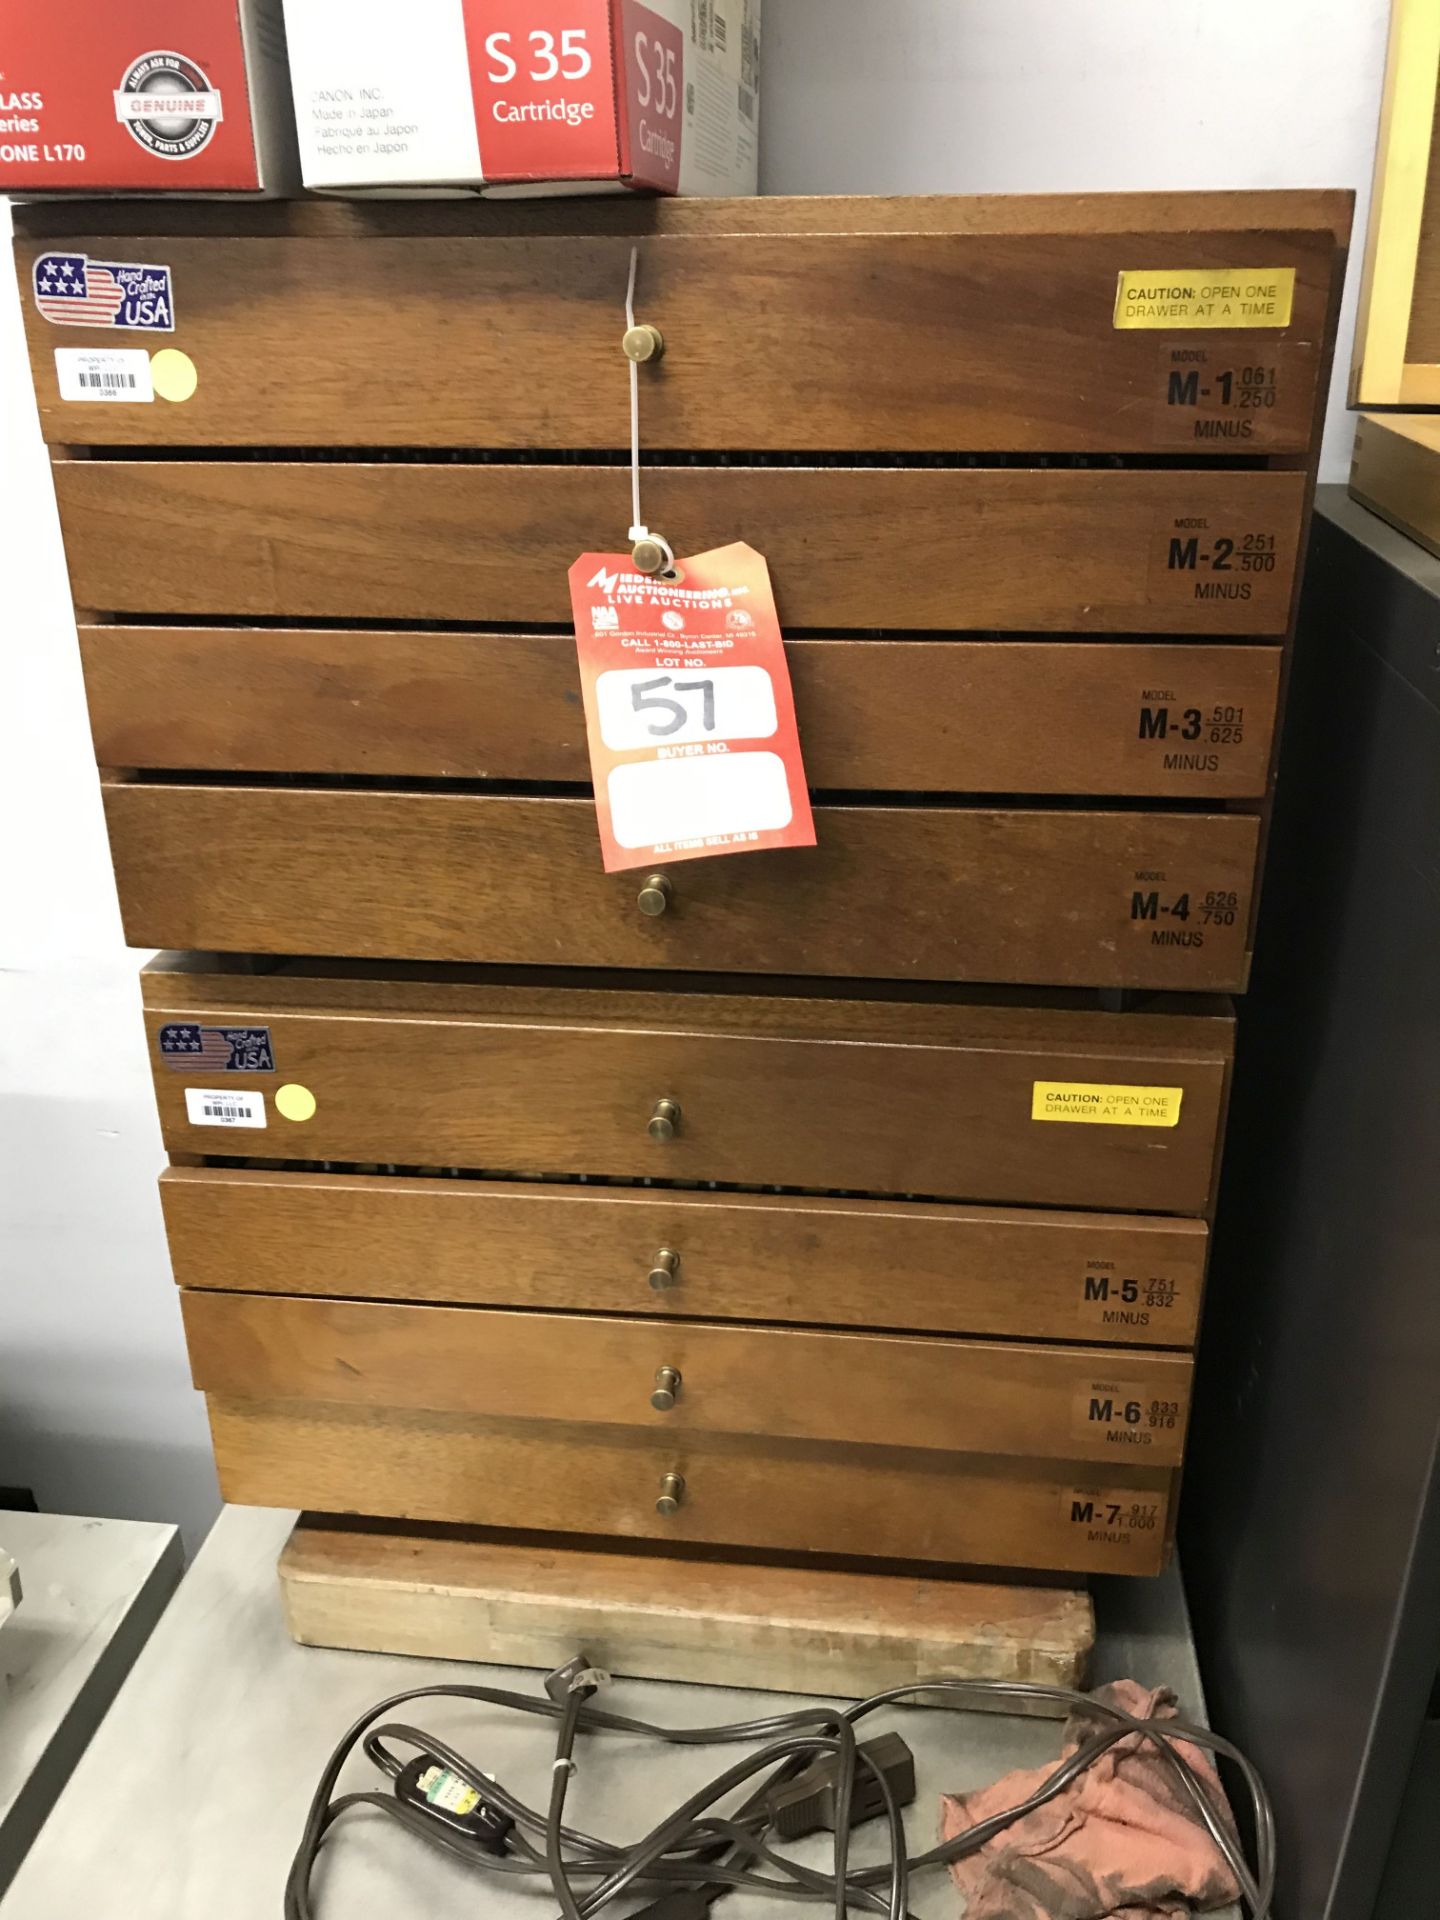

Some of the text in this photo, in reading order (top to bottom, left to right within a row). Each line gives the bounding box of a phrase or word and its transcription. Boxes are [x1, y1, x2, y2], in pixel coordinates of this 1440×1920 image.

[149, 57, 165, 69] ASK
[165, 57, 180, 70] FOR
[484, 29, 592, 83] S 35
[634, 31, 651, 107] S
[654, 40, 677, 119] 35
[130, 99, 206, 113] GENUINE
[360, 106, 394, 120] Japan
[492, 100, 595, 126] Cartridge
[154, 140, 179, 153] PARTS
[184, 120, 210, 151] SUPPLIES
[384, 123, 418, 136] Japon
[44, 144, 85, 162] L170
[374, 142, 408, 154] Japon
[639, 119, 675, 171] Cartridge
[116, 267, 143, 284] Hand
[127, 275, 166, 296] Crafted
[1126, 285, 1277, 301] CAUTION: OPEN ONE
[125, 296, 169, 325] USA
[1125, 302, 1275, 317] DRAWER AT A TIME
[1171, 350, 1208, 362] MODEL
[1167, 371, 1233, 405] M-1
[1194, 420, 1252, 437] MINUS
[1174, 518, 1210, 529] MODEL
[1167, 537, 1234, 570] M-2
[1194, 583, 1252, 600] MINUS
[608, 595, 733, 609] LIVE AUCTIONS
[621, 638, 734, 649] CALL 1-800-LAST-BID
[656, 657, 707, 667] LOT NO.
[1142, 690, 1176, 701] MODEL
[631, 676, 715, 736] 57
[1139, 707, 1202, 740] M-3
[657, 742, 730, 759] BUYER NO.
[1163, 754, 1219, 772] MINUS
[653, 843, 673, 854] ALL
[1130, 891, 1190, 921] M-4
[1151, 930, 1204, 948] MINUS
[235, 1048, 271, 1069] USA
[1046, 1092, 1168, 1107] CAUTION: OPEN ONE
[1045, 1104, 1168, 1118] DRAWER AT A TIME
[1084, 1277, 1138, 1303] M-5
[1102, 1311, 1150, 1326] MINUS
[1088, 1399, 1141, 1424] M-6
[1106, 1430, 1152, 1445] MINUS
[1071, 1501, 1121, 1525] M-7
[1087, 1530, 1132, 1544] MINUS
